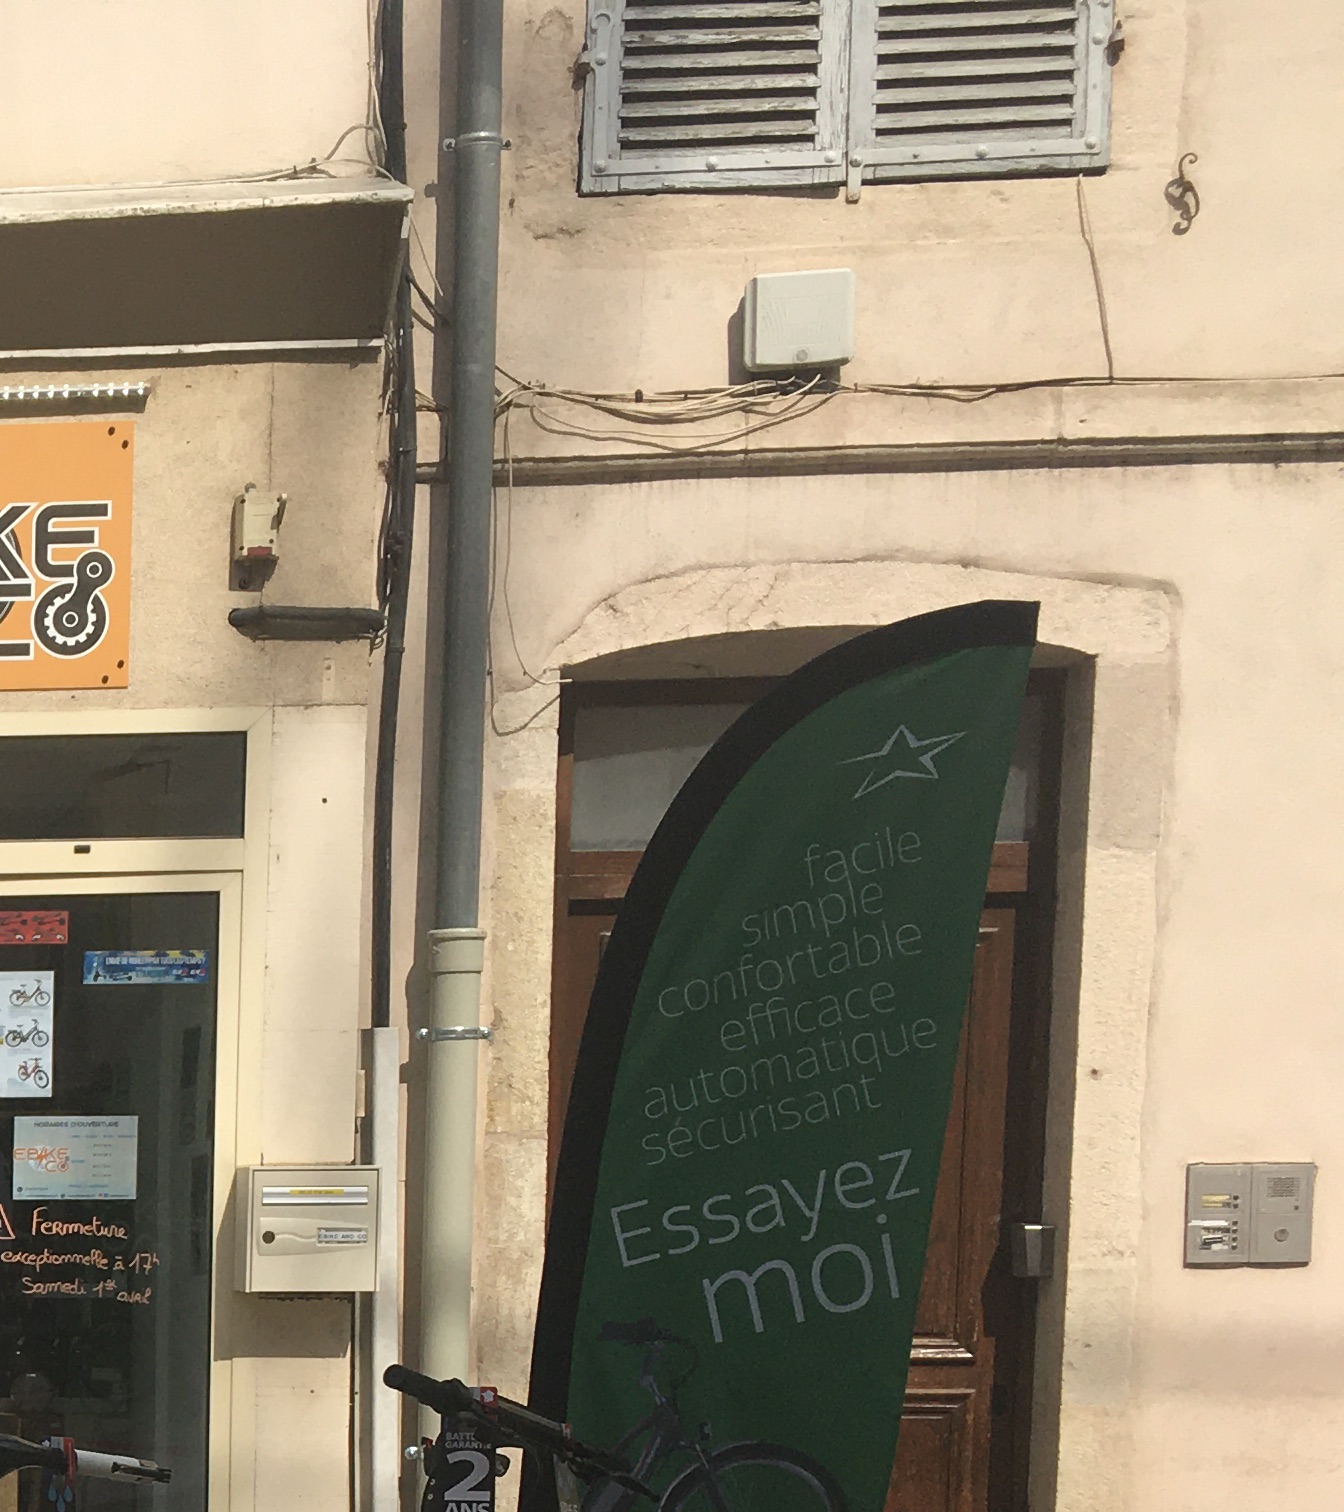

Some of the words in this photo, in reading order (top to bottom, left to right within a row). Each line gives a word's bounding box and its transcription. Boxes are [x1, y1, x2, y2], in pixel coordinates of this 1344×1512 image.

[804, 826, 922, 889] facile
[742, 874, 884, 947] simple
[658, 920, 922, 1018] confortable
[721, 982, 896, 1051] efficace
[644, 1018, 938, 1119] automatique
[641, 1074, 883, 1165] sécurisant
[611, 1149, 921, 1267] Essayez
[21, 1276, 87, 1295] Samedi
[702, 1213, 901, 1344] moi
[444, 1450, 491, 1502] 2
